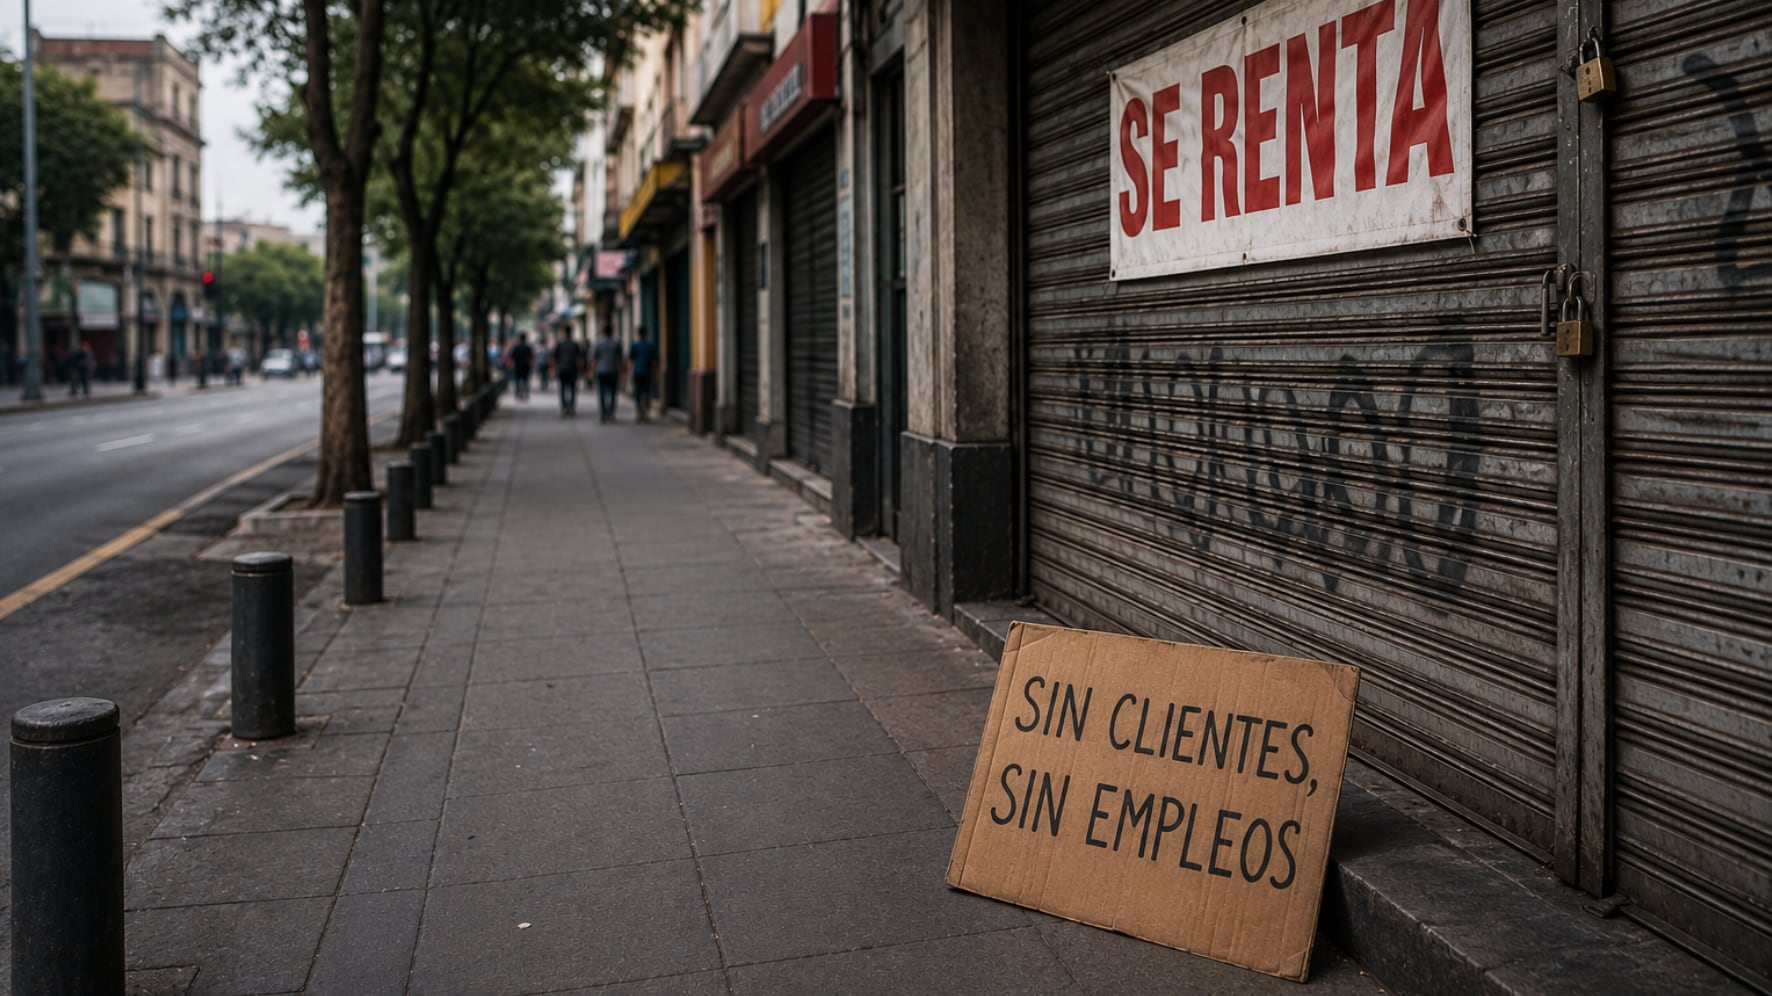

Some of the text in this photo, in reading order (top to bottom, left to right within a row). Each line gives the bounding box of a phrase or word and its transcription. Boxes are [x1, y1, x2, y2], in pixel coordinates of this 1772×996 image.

[1119, 0, 1455, 238] SE RENTA
[1015, 676, 1318, 798] SIN CLIENTES,
[990, 763, 1301, 890] SIN EMPLEOS
